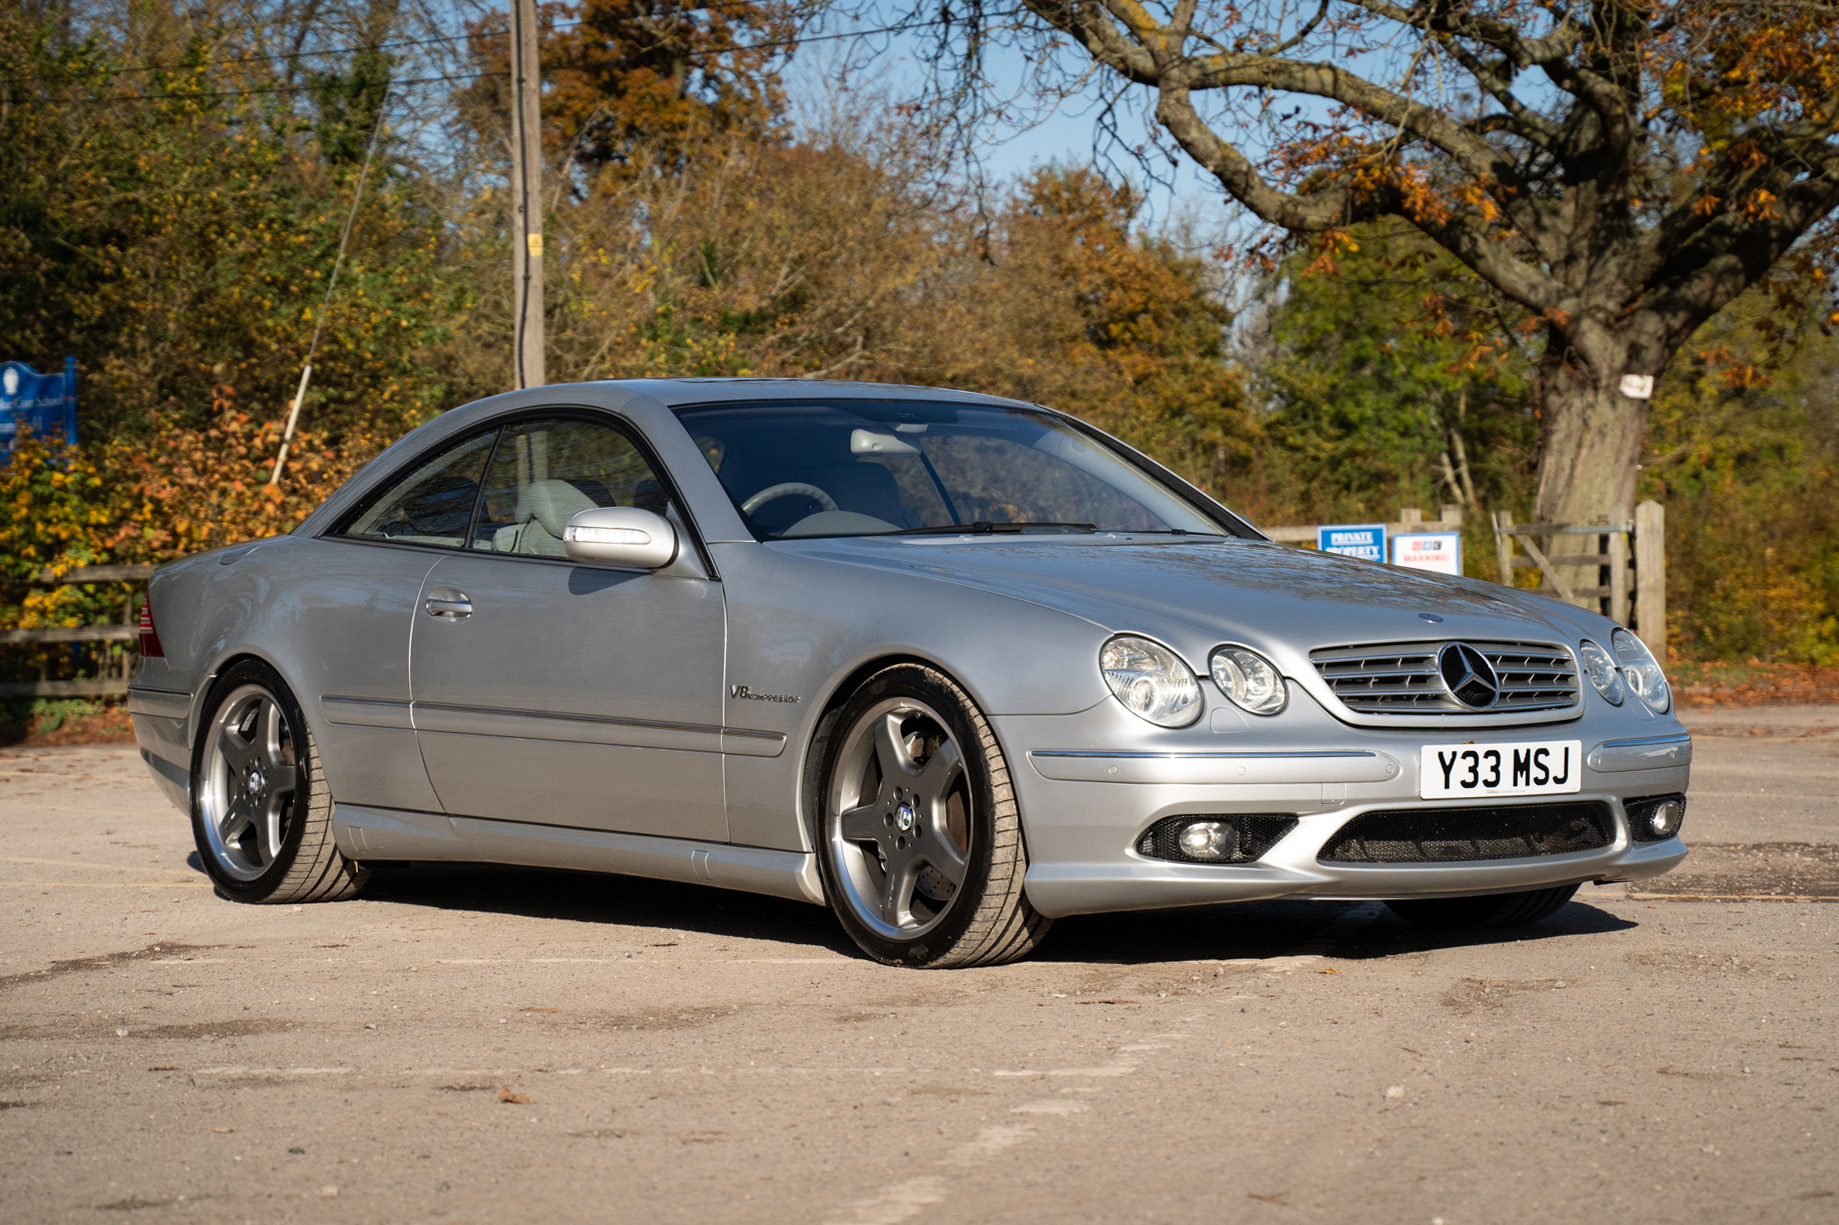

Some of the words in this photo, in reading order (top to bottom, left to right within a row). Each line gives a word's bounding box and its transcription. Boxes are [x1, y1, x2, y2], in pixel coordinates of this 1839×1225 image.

[1330, 532, 1373, 543] PRIVATE
[730, 685, 750, 698] V8
[1437, 750, 1501, 790] Y33
[1512, 747, 1570, 787] MSJ
